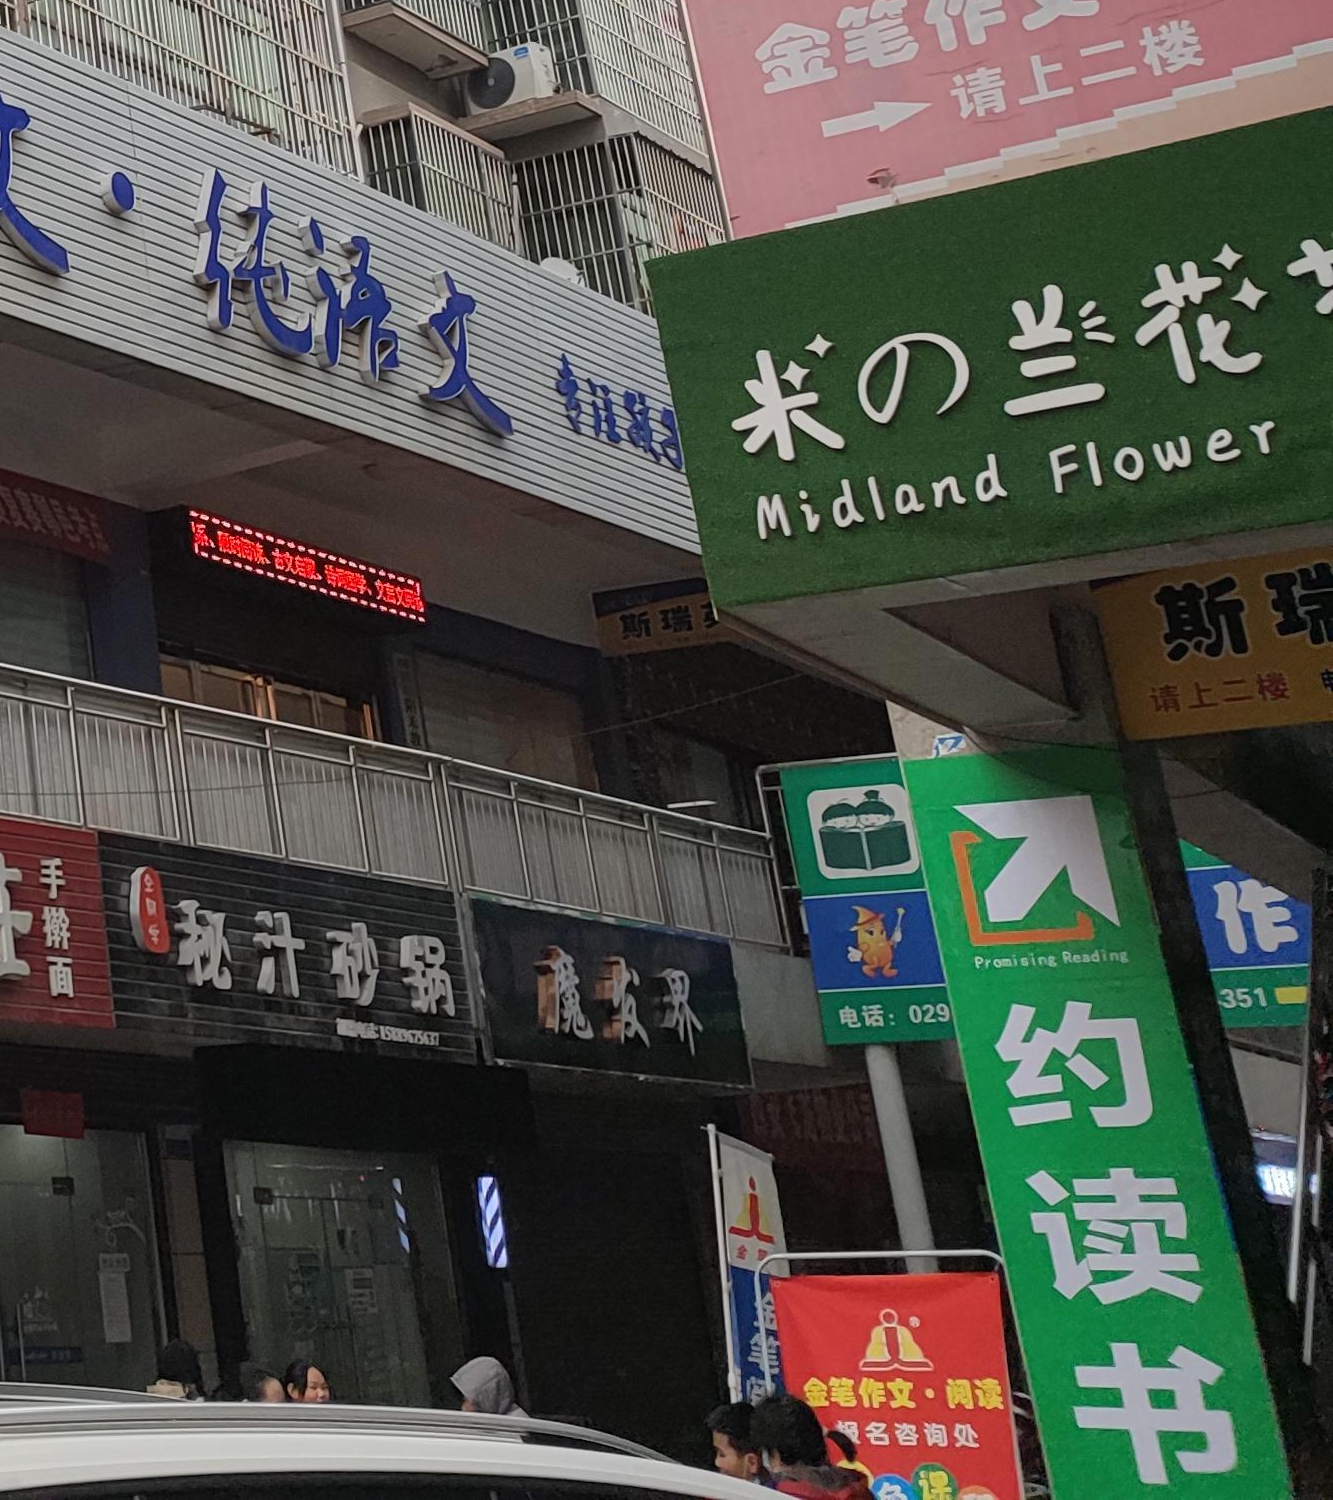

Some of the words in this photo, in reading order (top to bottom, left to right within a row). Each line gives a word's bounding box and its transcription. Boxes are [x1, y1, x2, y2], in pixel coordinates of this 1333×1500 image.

[951, 19, 1205, 119] 请上二楼
[756, 453, 1008, 540] Midland
[1049, 420, 1276, 494] Flower
[1154, 561, 1333, 661] 斯瑞
[1149, 671, 1290, 713] 请上二楼
[39, 857, 75, 998] 手擀面
[173, 899, 456, 1018] 秘汁砂锅
[974, 953, 1058, 971] Promising
[1062, 949, 1130, 967] Reading
[1214, 878, 1300, 955] 作
[838, 1005, 896, 1030] 电话：
[908, 1002, 950, 1026] 029
[1218, 986, 1267, 1011] 351
[994, 1000, 1238, 1485] 约读书
[802, 1376, 1005, 1410] 金笔作文·阅读
[835, 1420, 981, 1449] 报名咨询处
